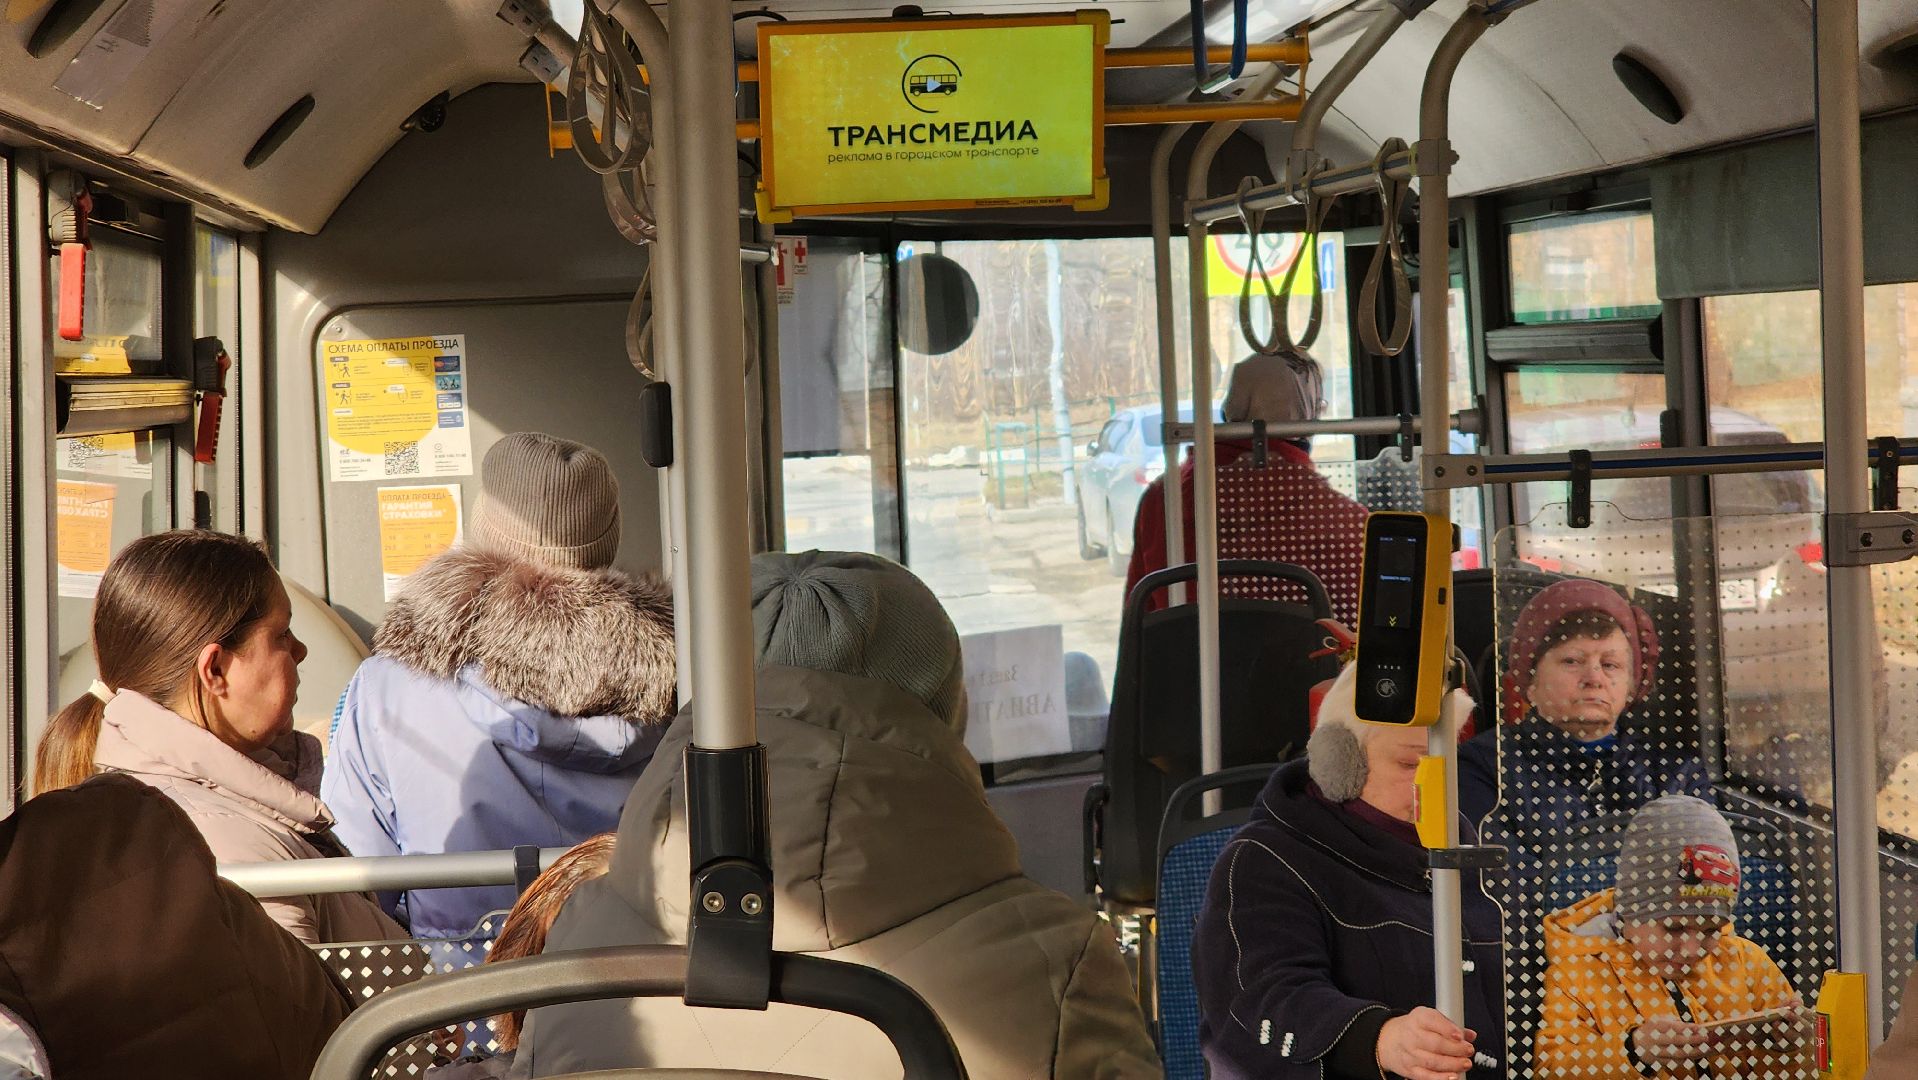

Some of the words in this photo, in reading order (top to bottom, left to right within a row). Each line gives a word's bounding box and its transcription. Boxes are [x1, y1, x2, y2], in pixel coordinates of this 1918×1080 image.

[827, 119, 1039, 148] ТРАНСМЕДИА
[828, 152, 883, 164] реклама
[885, 152, 892, 161] в
[895, 149, 962, 162] городском
[966, 147, 1039, 160] транспорте
[328, 344, 364, 354] СХЕМА
[366, 341, 410, 353] ОПЛАТЫ
[413, 338, 459, 350] ПРОЕЗДА
